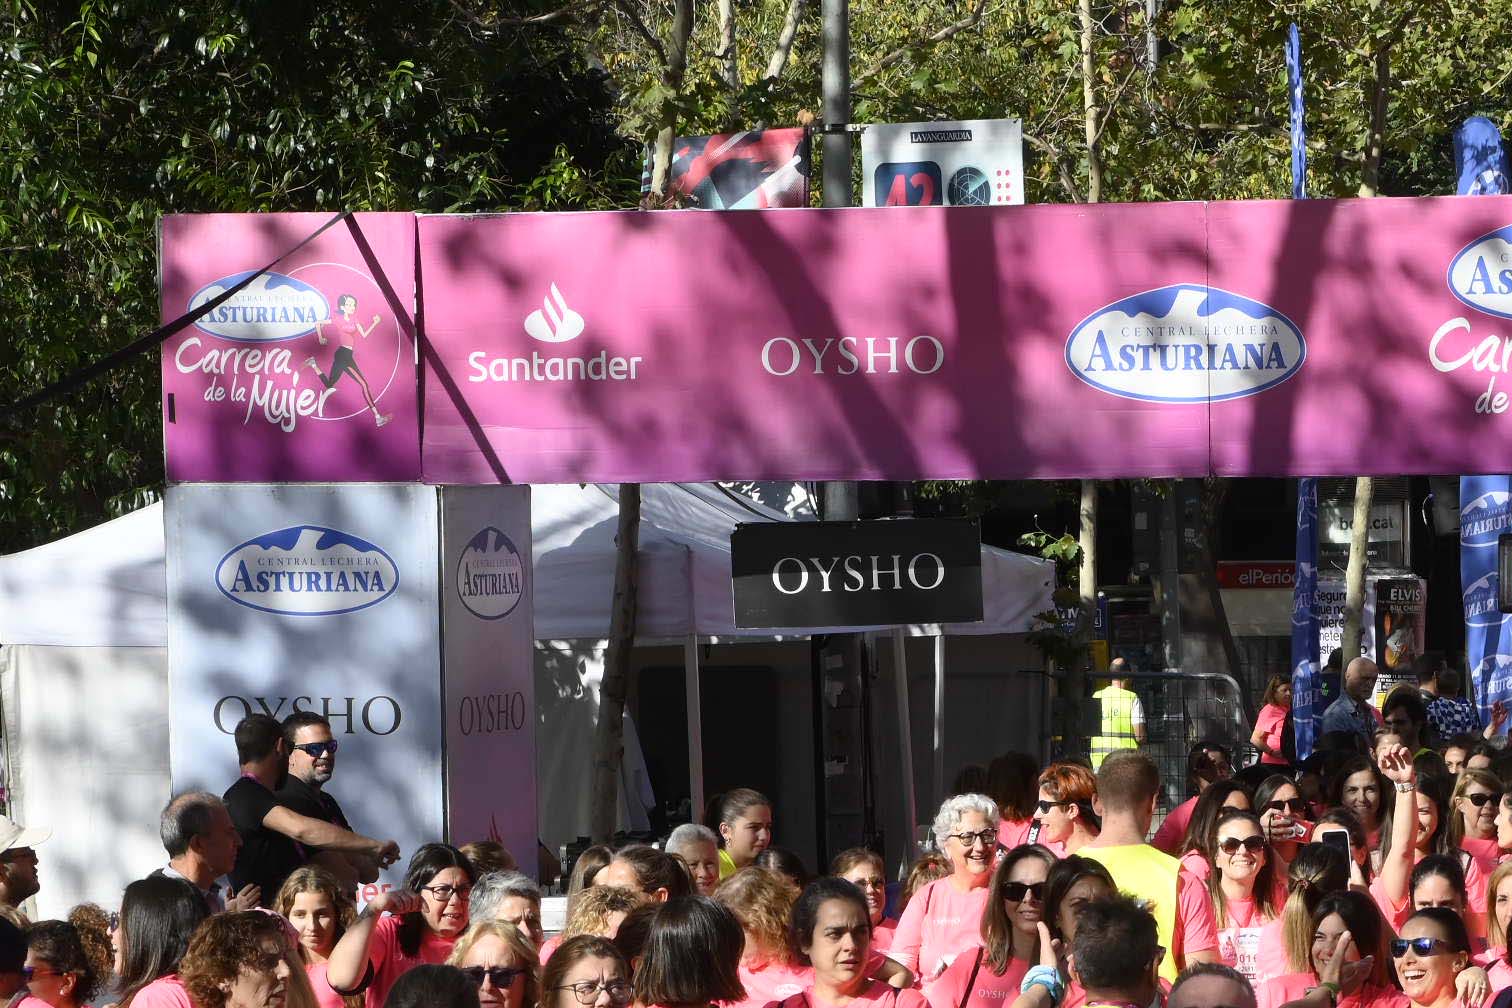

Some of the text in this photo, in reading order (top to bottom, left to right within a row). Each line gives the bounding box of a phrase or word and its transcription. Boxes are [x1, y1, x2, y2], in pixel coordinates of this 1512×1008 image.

[1121, 324, 1279, 336] CENTRAL LECHERA
[175, 337, 293, 374] Carrera
[468, 351, 642, 381] Santander
[762, 335, 944, 375] OYSHO
[1085, 330, 1287, 371] ASTURIANA
[204, 371, 337, 433] de la Mujer
[1475, 376, 1510, 414] de
[230, 560, 385, 594] ASTURIANA
[257, 557, 379, 566] CENTRAL LECHERA
[463, 561, 520, 597] ASTURIANA
[773, 552, 945, 595] OYSHO
[1390, 588, 1421, 600] ELVIS
[460, 692, 525, 736] OYSHO
